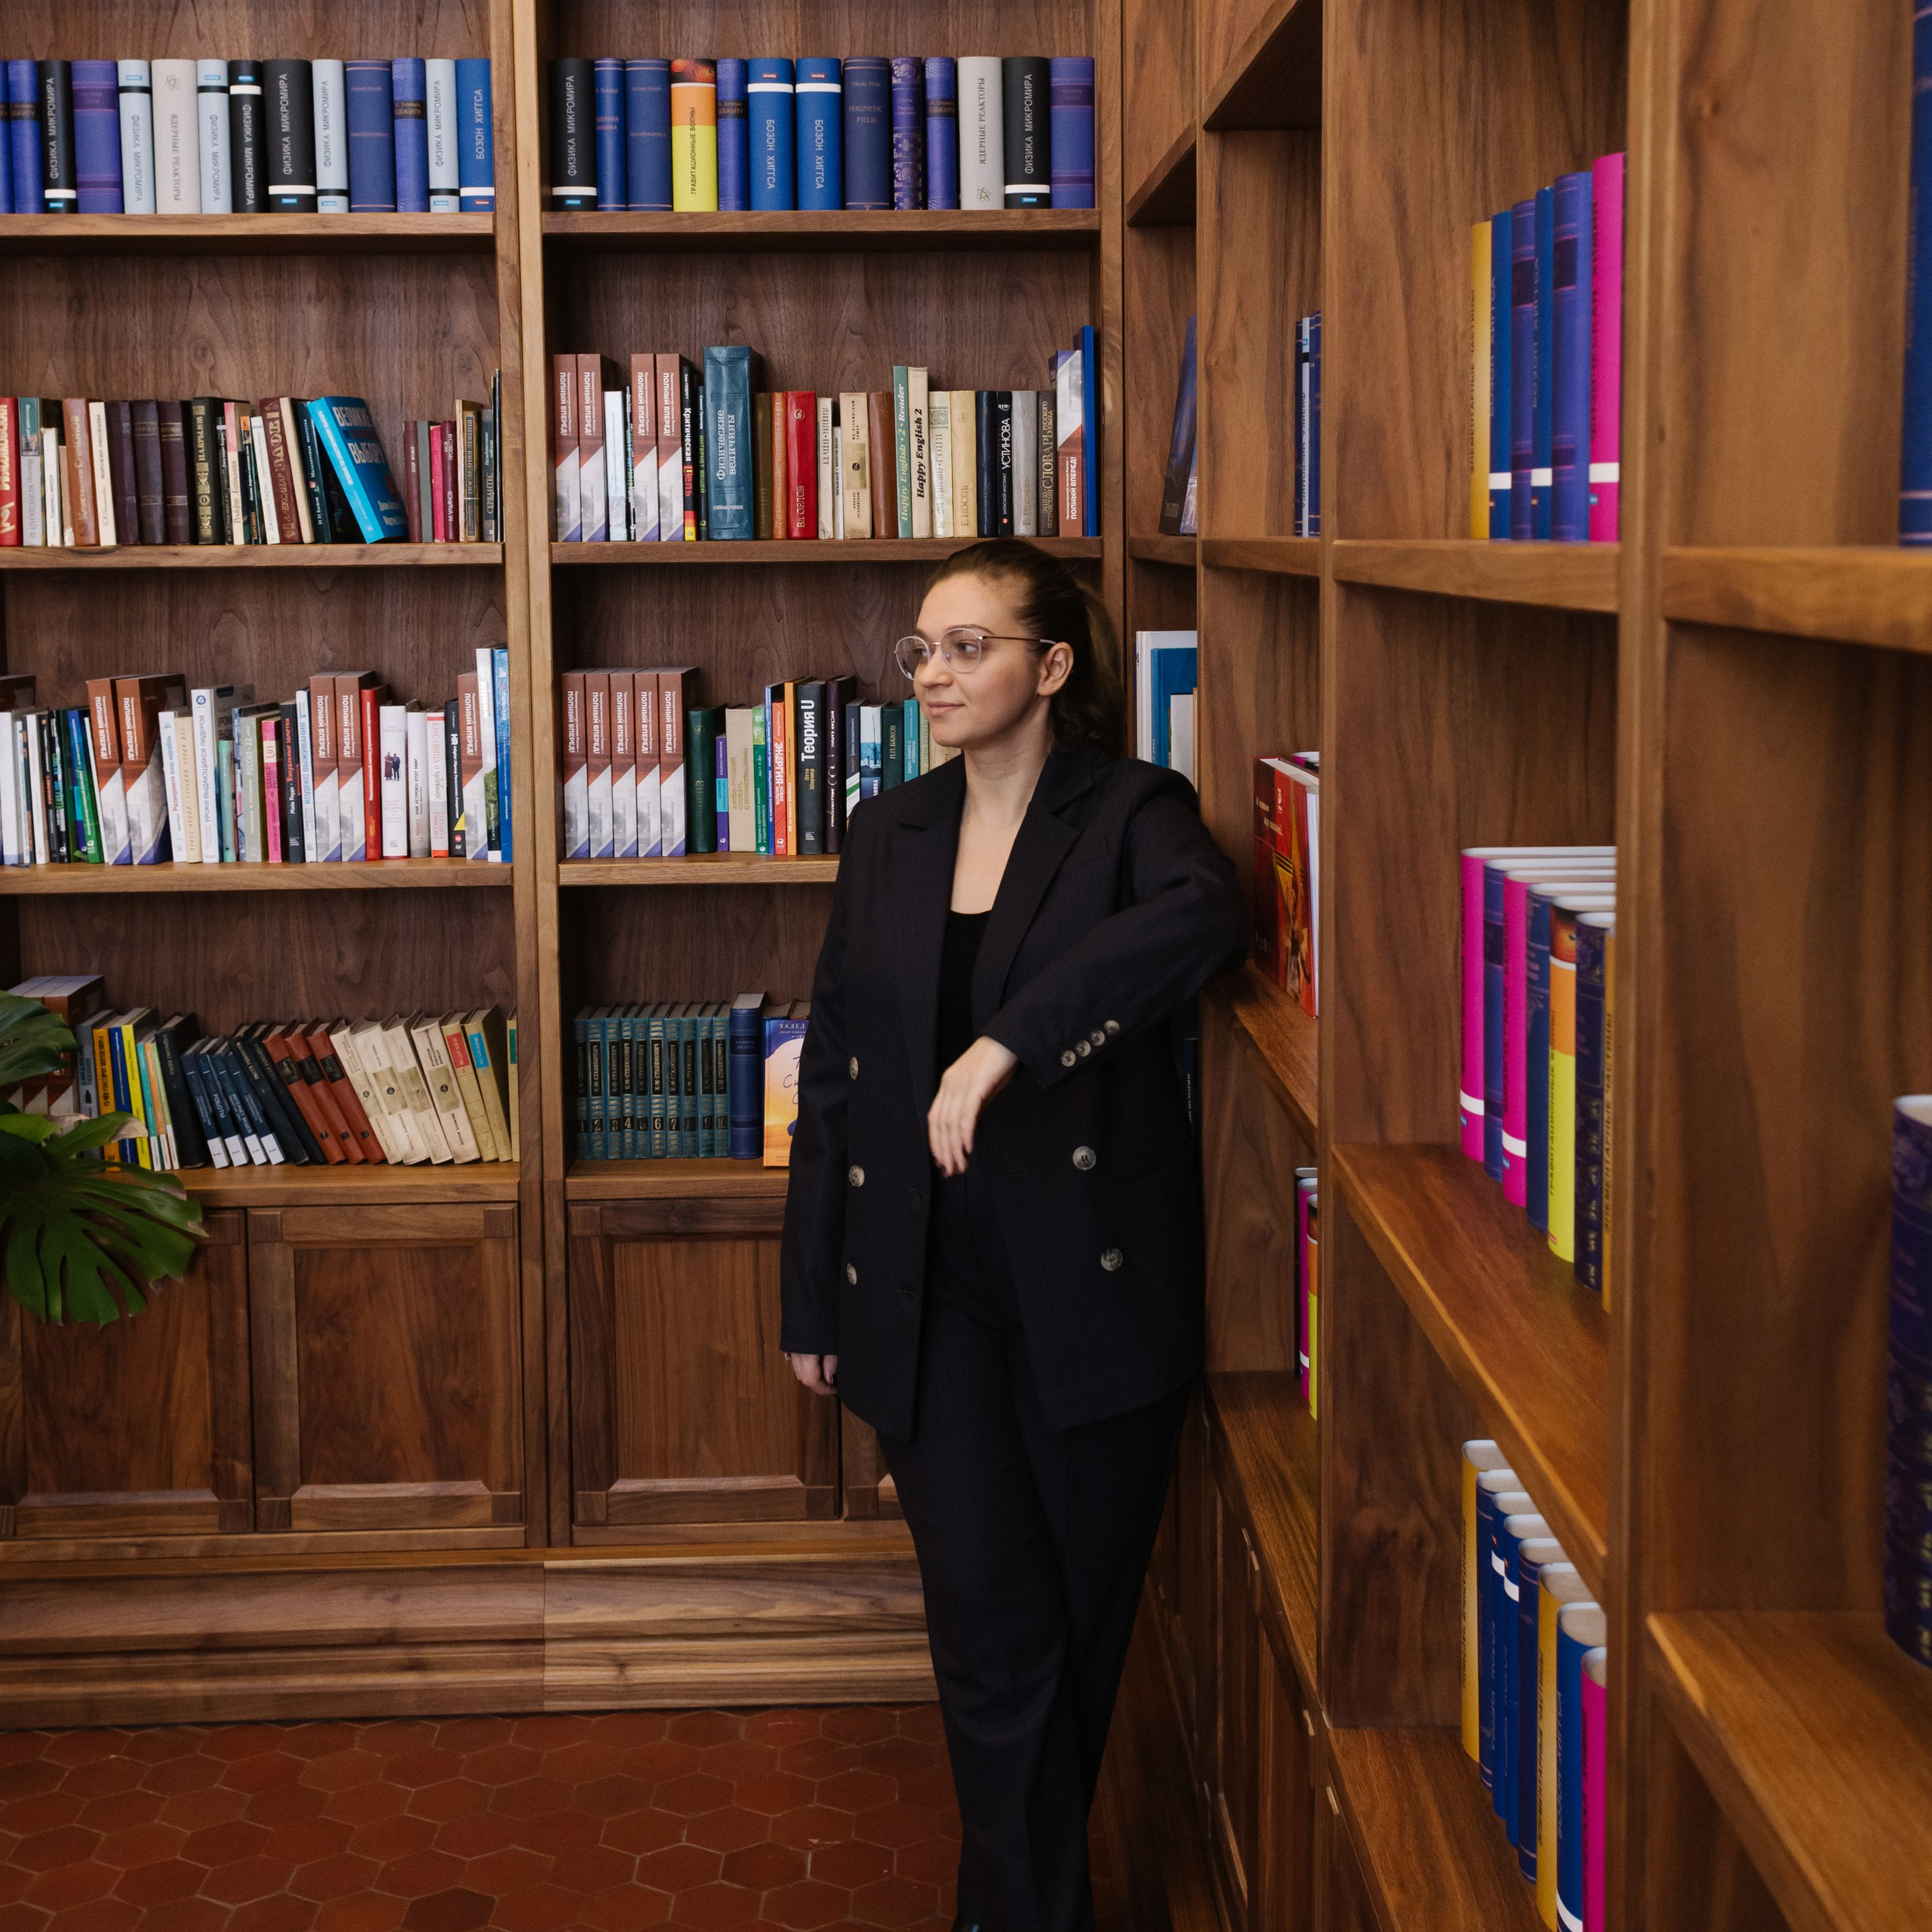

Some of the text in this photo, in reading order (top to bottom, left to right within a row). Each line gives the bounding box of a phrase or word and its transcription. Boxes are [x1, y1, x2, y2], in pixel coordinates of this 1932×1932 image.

[48, 77, 59, 179] ФИЗИКА МИКРОМИРА
[279, 74, 293, 174] ФИЗИКА МИКРОМИРА
[321, 80, 332, 167] ФИЗИКА МИКРОМИРА
[433, 80, 444, 167] ФИЗИКА МИКРОМИРА
[475, 89, 485, 159] БОЗОН ХИГГСА
[566, 75, 577, 176] ФИЗИКА МИКРОМИРА
[131, 115, 143, 202] ФИЗИКА МИКРОМИРА
[210, 114, 220, 202] ФИЗИКА МИКРОМИРА
[242, 104, 254, 205] ФИЗИКА МИКРОМИРА
[766, 119, 776, 189] БОЗОН ХИГГСА
[814, 119, 824, 189] БОЗОН ХИГГСА
[1025, 136, 1033, 174] ФИЗИКА
[717, 410, 725, 480] Физические
[915, 420, 924, 460] English
[1001, 418, 1011, 469] УСТИНОВА
[1042, 430, 1054, 489] СЛОВАРЬ
[486, 472, 494, 513] СЕРВАНТЕС
[683, 465, 693, 497] Цепь
[900, 429, 909, 521] Happy English 2
[916, 462, 927, 498] Happy
[95, 697, 107, 759] ПОЛНЫЙ ВПЕРЕД!
[124, 697, 133, 730] ПОЛНЫЙ
[801, 700, 817, 762] Теория U
[300, 722, 310, 804] КОДЕКС ВЫЖИВАНИЯ
[431, 722, 442, 800] КРАСАВИЦА чудовище
[451, 734, 458, 745] HR
[775, 742, 783, 784] ЭНЕРГИЯ
[201, 748, 209, 798] ВЫДАЮЩИХСЯ
[213, 1094, 226, 1119] РОБОТЫ
[594, 1118, 601, 1131] 2
[612, 1118, 618, 1131] 3
[625, 1117, 631, 1128] 4
[640, 1118, 645, 1130] 5
[654, 1118, 661, 1129] 6
[671, 1118, 676, 1130] 7
[704, 1116, 710, 1128] 9
[718, 1116, 727, 1129] 10
